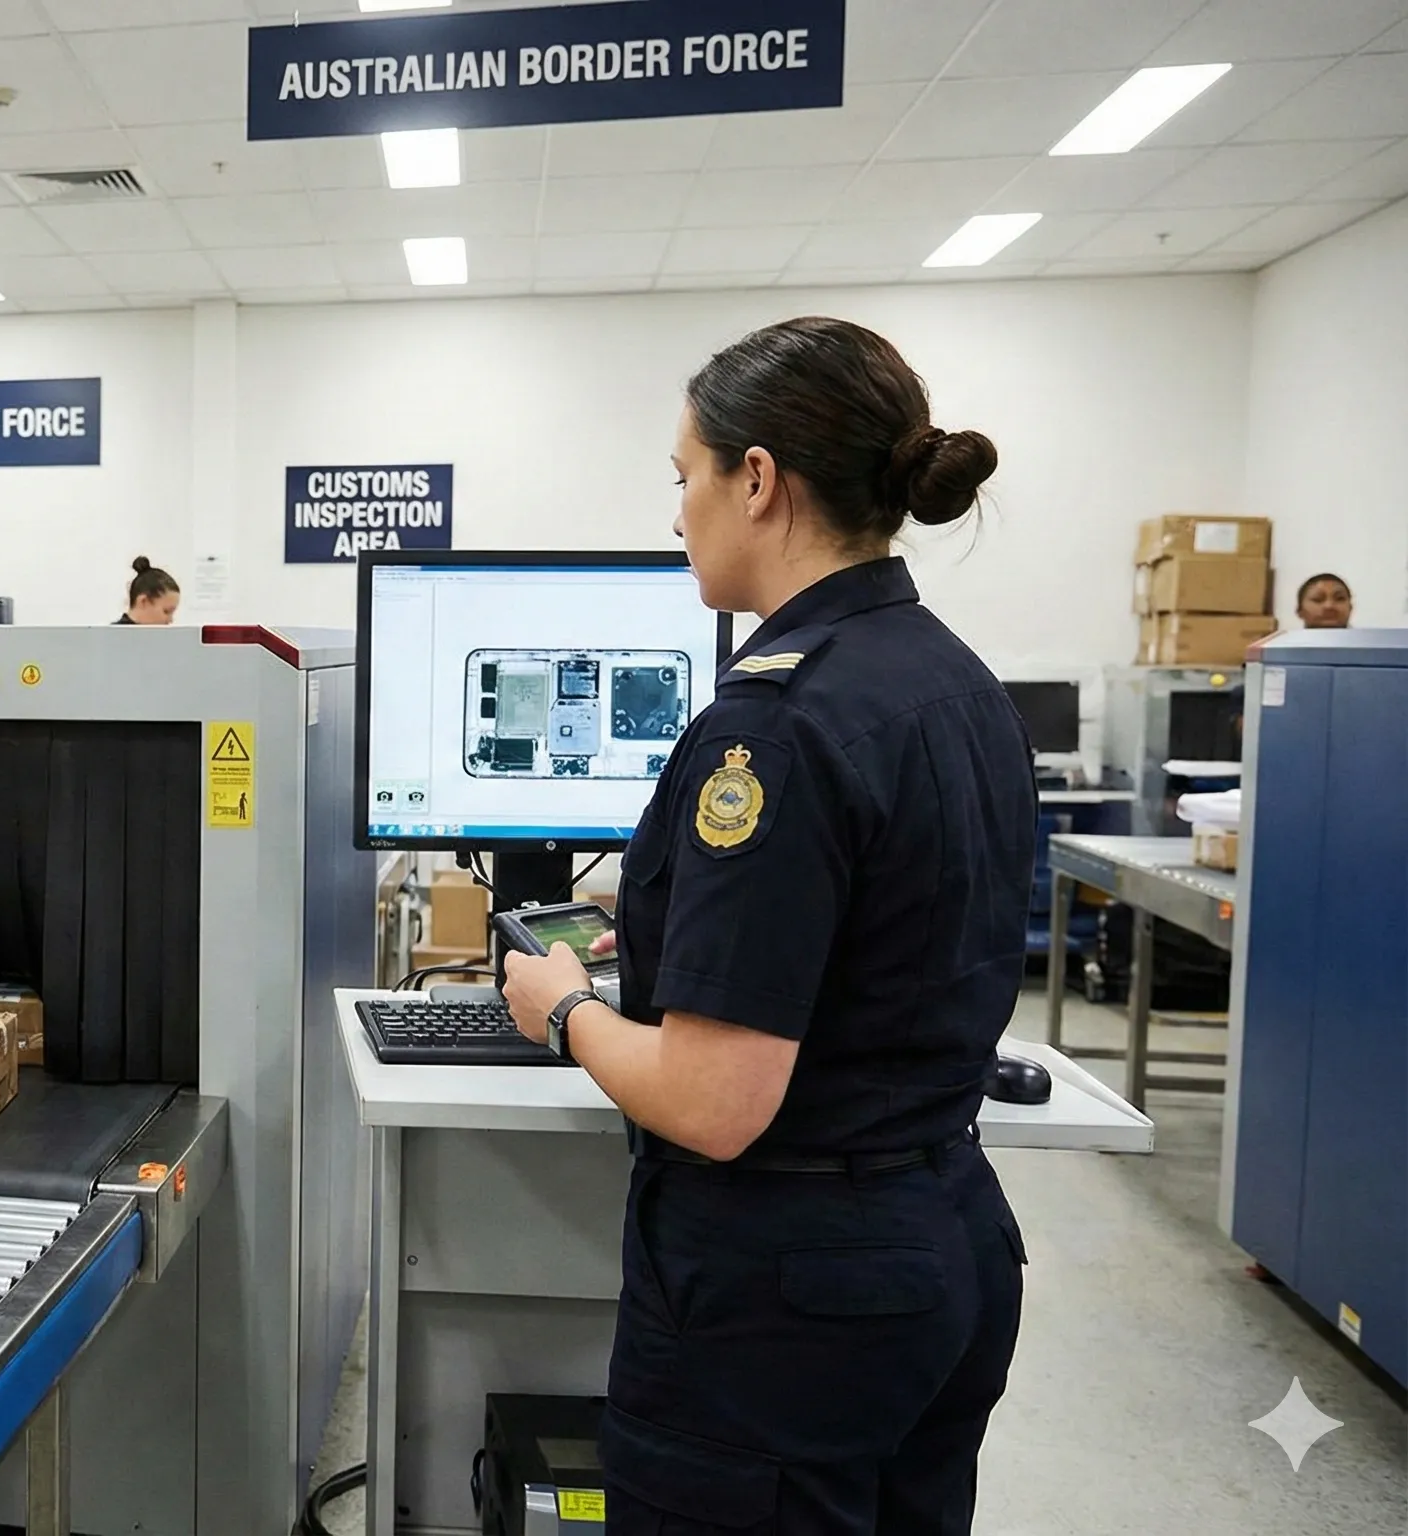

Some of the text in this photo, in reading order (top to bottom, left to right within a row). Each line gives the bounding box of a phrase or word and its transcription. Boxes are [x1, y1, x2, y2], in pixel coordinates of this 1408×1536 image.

[279, 29, 809, 101] AUSTRALIAN BORDER FORCE
[2, 406, 86, 438] FORCE
[307, 470, 430, 498] CUSTOMS
[294, 501, 443, 528] INSPECTION
[333, 530, 401, 557] AREA
